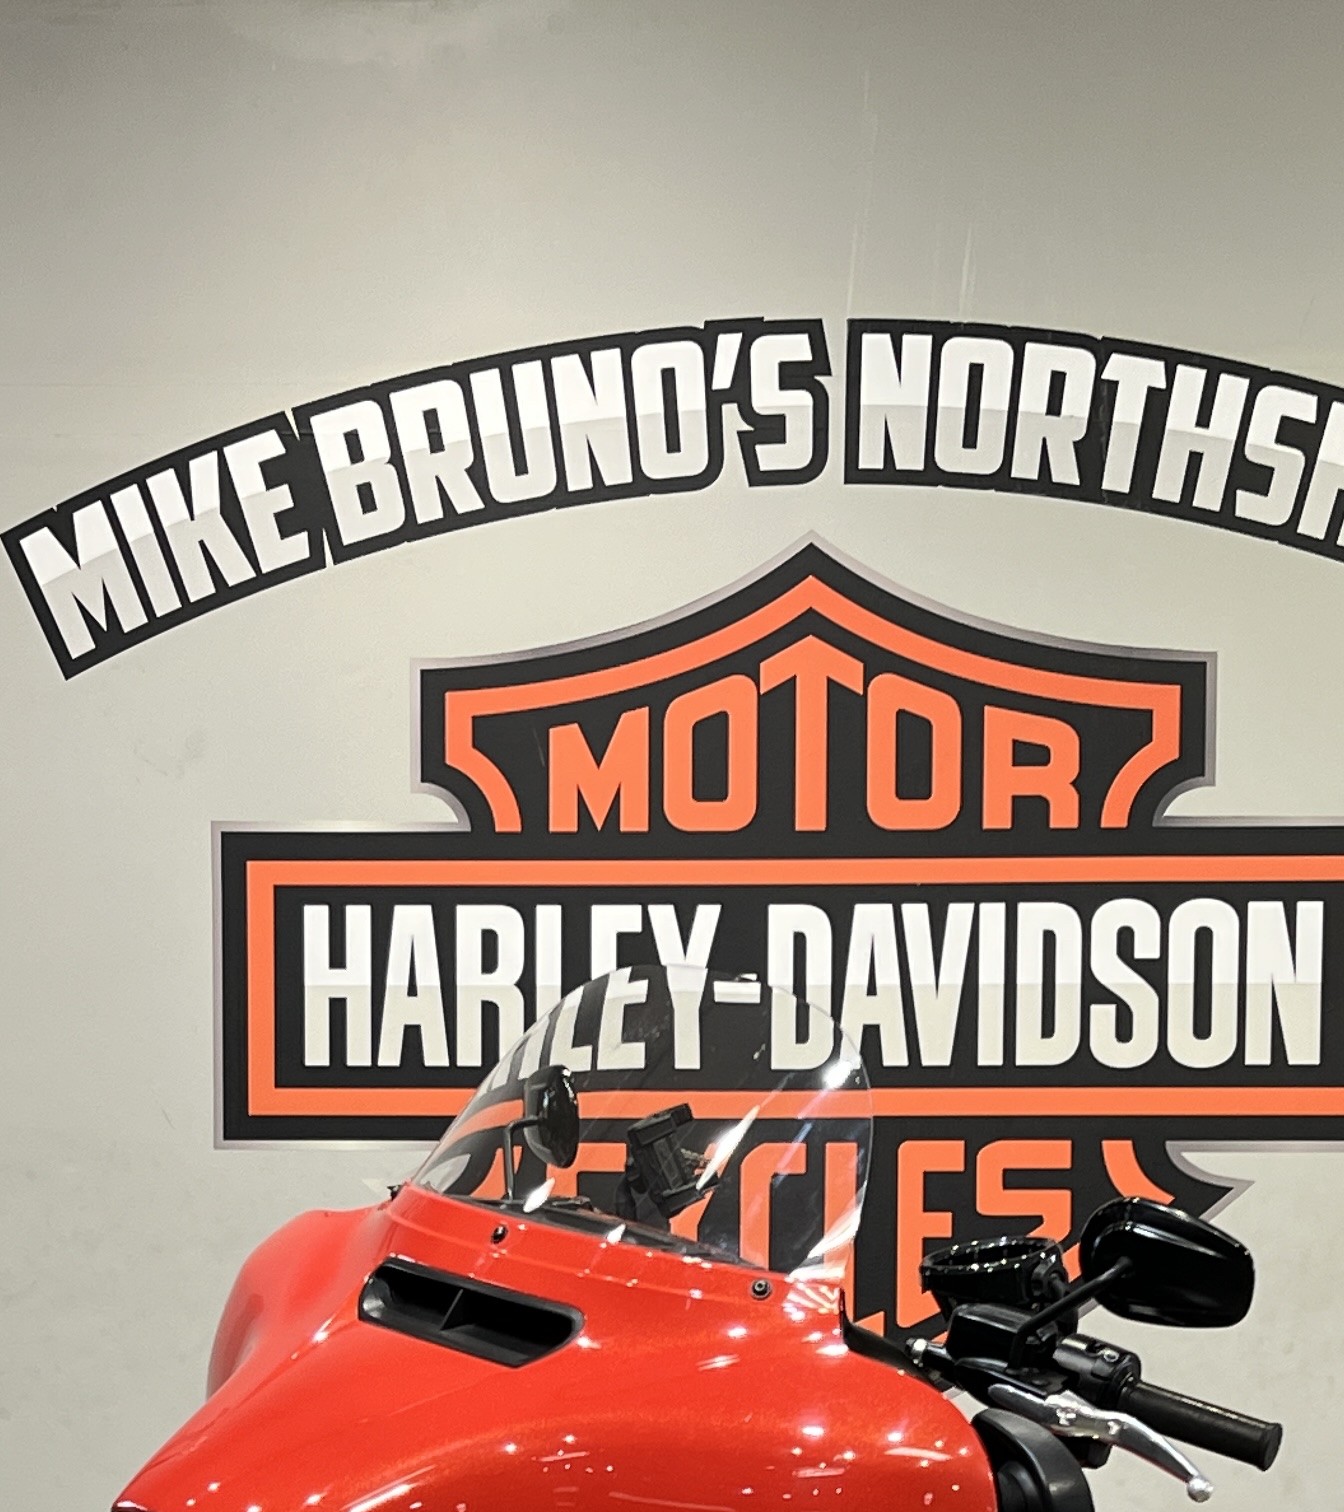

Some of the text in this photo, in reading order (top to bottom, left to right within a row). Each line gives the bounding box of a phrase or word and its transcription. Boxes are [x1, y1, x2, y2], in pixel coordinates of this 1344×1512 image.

[18, 429, 311, 660] MIKE
[309, 332, 814, 546] BRUNO'S
[548, 634, 1080, 833] MOTOR
[300, 897, 1327, 1071] HARLEY-DAVIDSON
